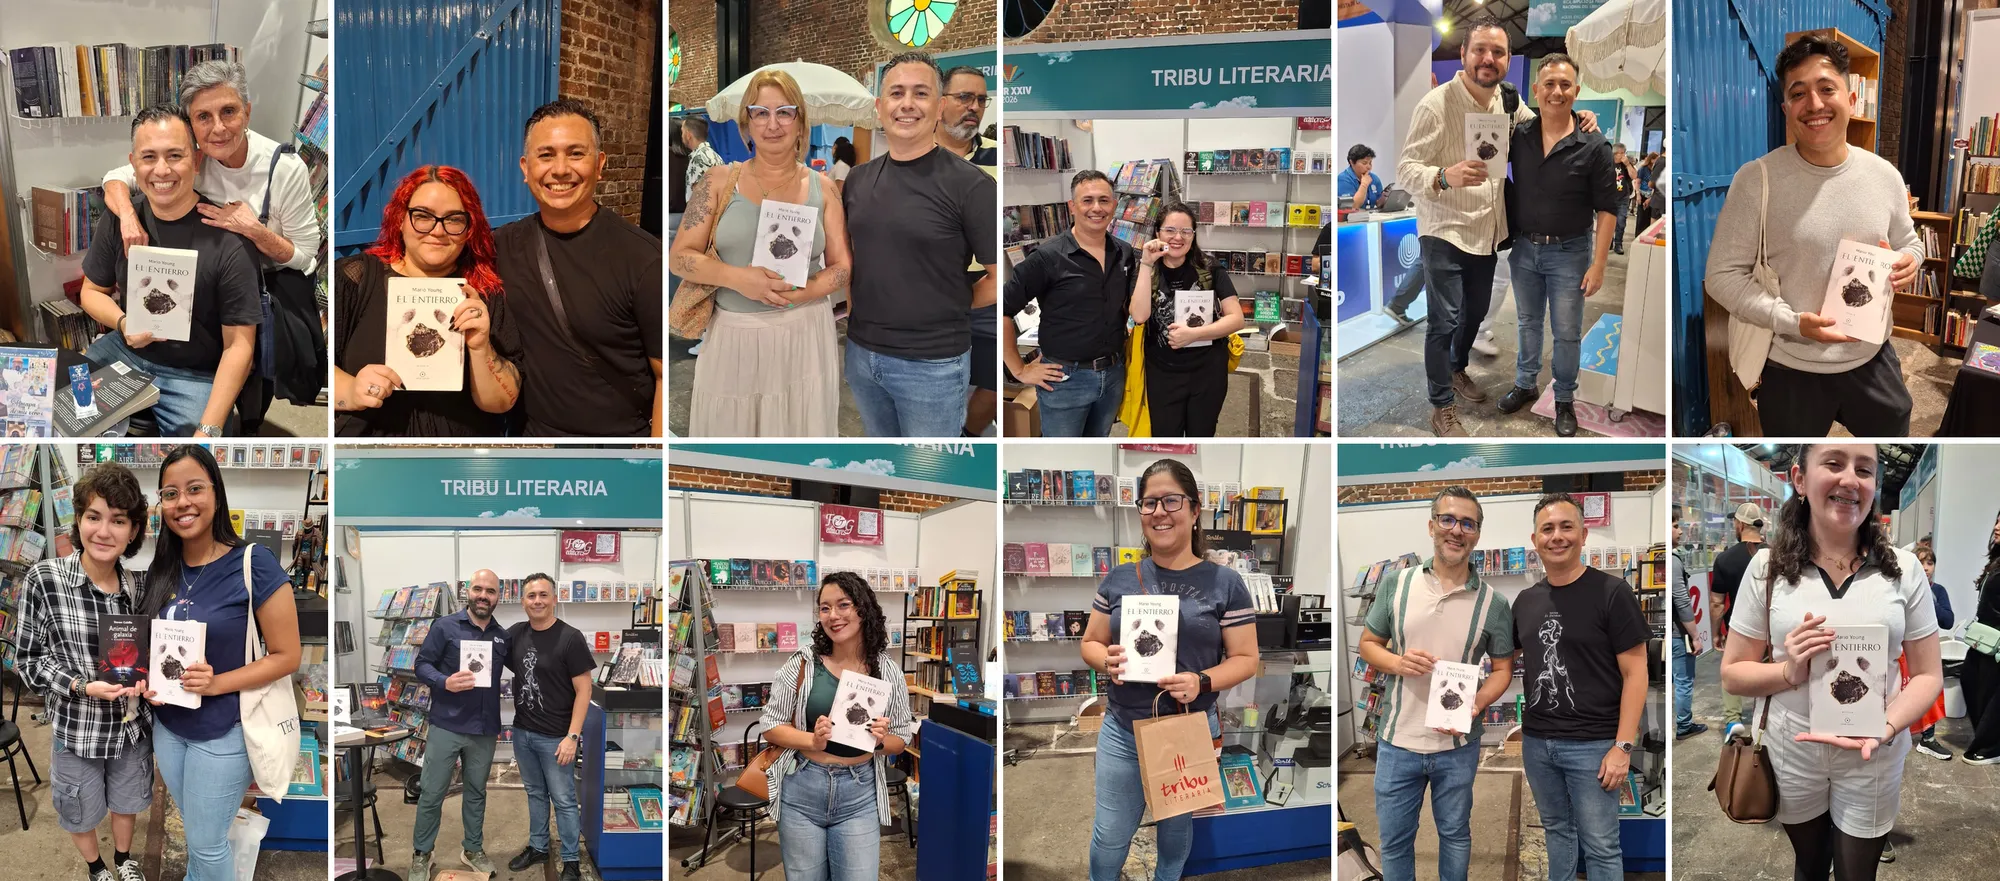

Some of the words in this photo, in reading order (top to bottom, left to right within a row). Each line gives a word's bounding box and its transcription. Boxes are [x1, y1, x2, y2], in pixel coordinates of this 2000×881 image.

[1151, 68, 1212, 86] TRIBU
[1219, 64, 1331, 85] LITERARIA
[1011, 86, 1032, 95] XXIV
[765, 211, 774, 219] EL
[135, 264, 144, 272] EL
[148, 265, 189, 277] ENTIERRO
[396, 295, 407, 303] EL
[412, 295, 458, 304] ENTIERRO
[441, 480, 499, 496] TRIBU
[505, 480, 608, 496] LITERARIA
[1138, 608, 1174, 616] ENTIERRO
[112, 631, 133, 639] galaxia
[164, 633, 195, 643] ENTIERRO
[1834, 643, 1881, 652] ENTIERRO
[1161, 775, 1208, 797] tribu
[1164, 788, 1212, 806] LITERARIA
